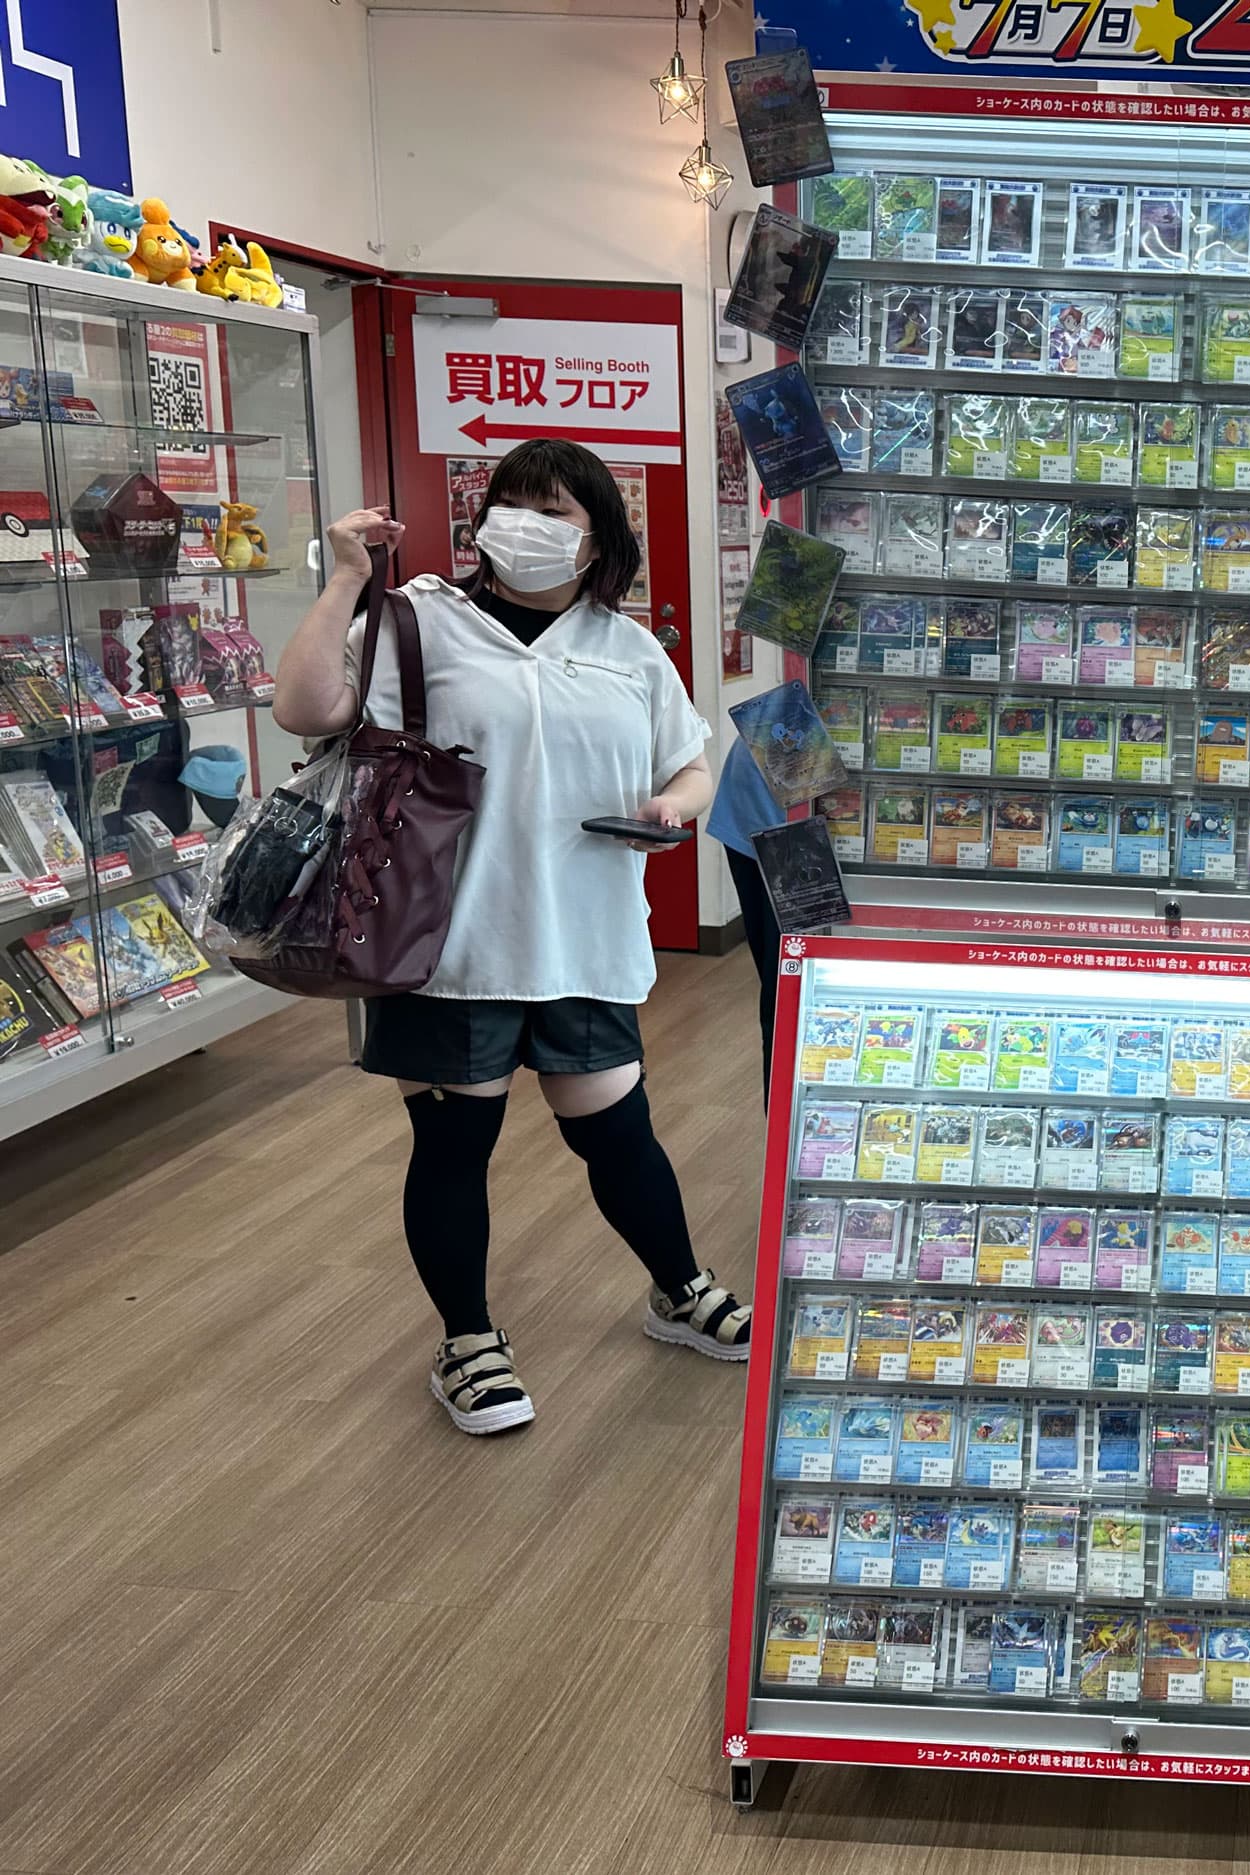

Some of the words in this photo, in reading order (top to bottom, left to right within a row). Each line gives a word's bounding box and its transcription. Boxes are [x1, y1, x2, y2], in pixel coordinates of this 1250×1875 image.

[959, 0, 1133, 60] 7月7日
[445, 352, 548, 407] 買取
[555, 378, 650, 411] フロア
[555, 357, 603, 374] Selling
[608, 358, 650, 374] Booth
